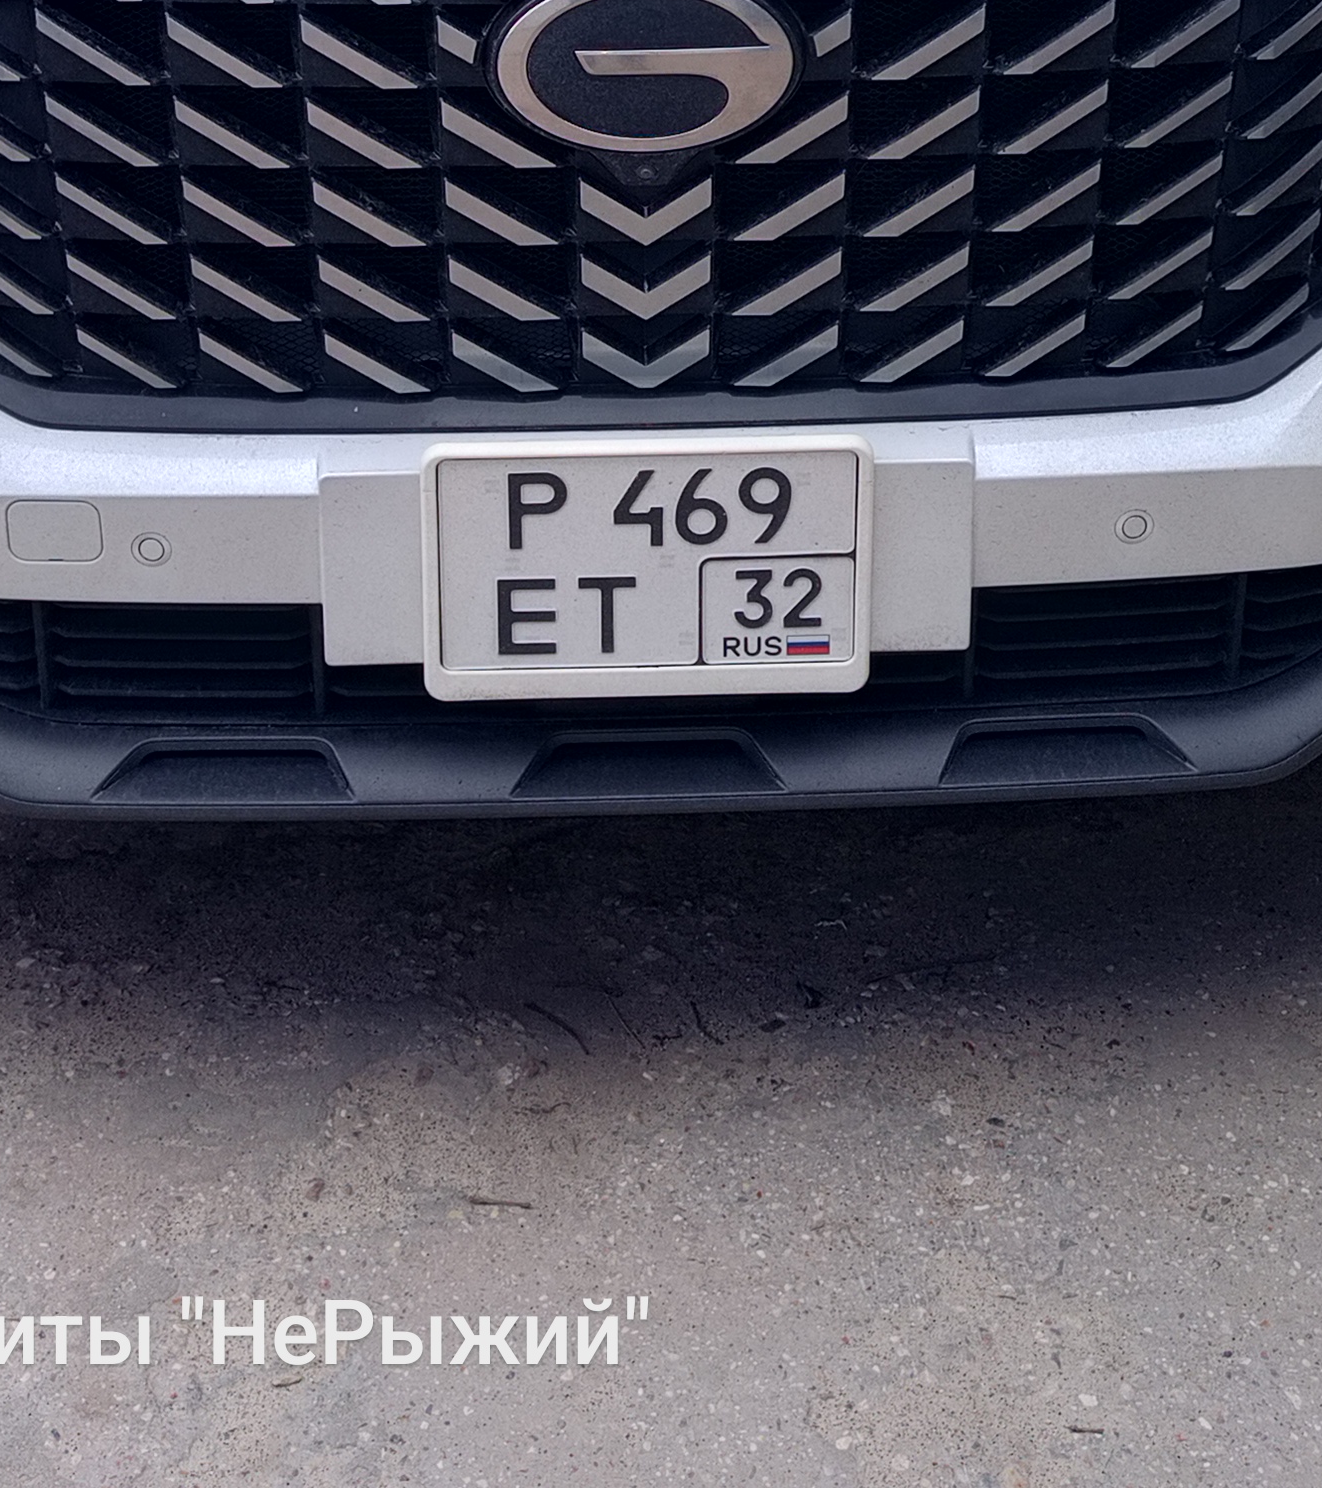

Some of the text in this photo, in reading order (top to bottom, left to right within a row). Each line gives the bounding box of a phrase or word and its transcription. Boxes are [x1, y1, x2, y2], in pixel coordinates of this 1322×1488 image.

[613, 467, 793, 547] 469
[733, 568, 823, 630] 32
[722, 634, 783, 658] RUS
